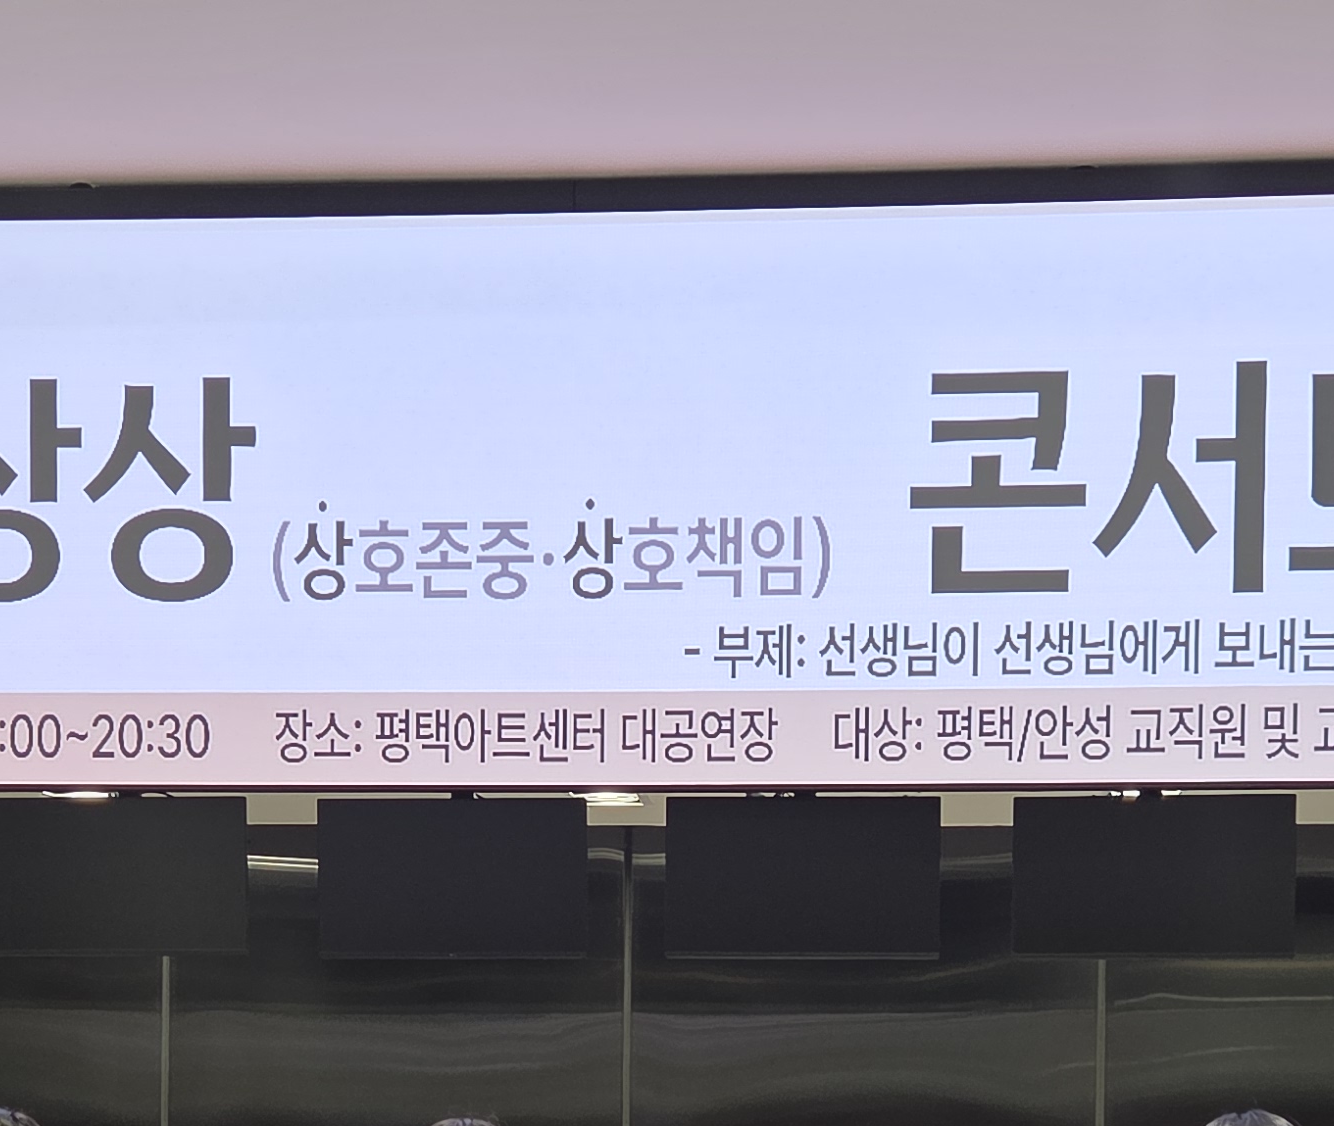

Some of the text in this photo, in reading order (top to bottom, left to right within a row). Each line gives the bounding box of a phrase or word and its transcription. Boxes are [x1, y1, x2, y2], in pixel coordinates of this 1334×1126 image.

[272, 498, 831, 602] (상호존중·상호책임)
[713, 623, 806, 679] 부제:
[818, 621, 979, 678] 선생님이
[994, 618, 1200, 676] 선생님에게
[275, 707, 779, 764] 장소: 평택아트센터 대공연장
[834, 706, 922, 762] 대상:
[936, 704, 1111, 763] 평택/안성
[1126, 703, 1246, 760] 교직원
[1263, 702, 1299, 759] 및
